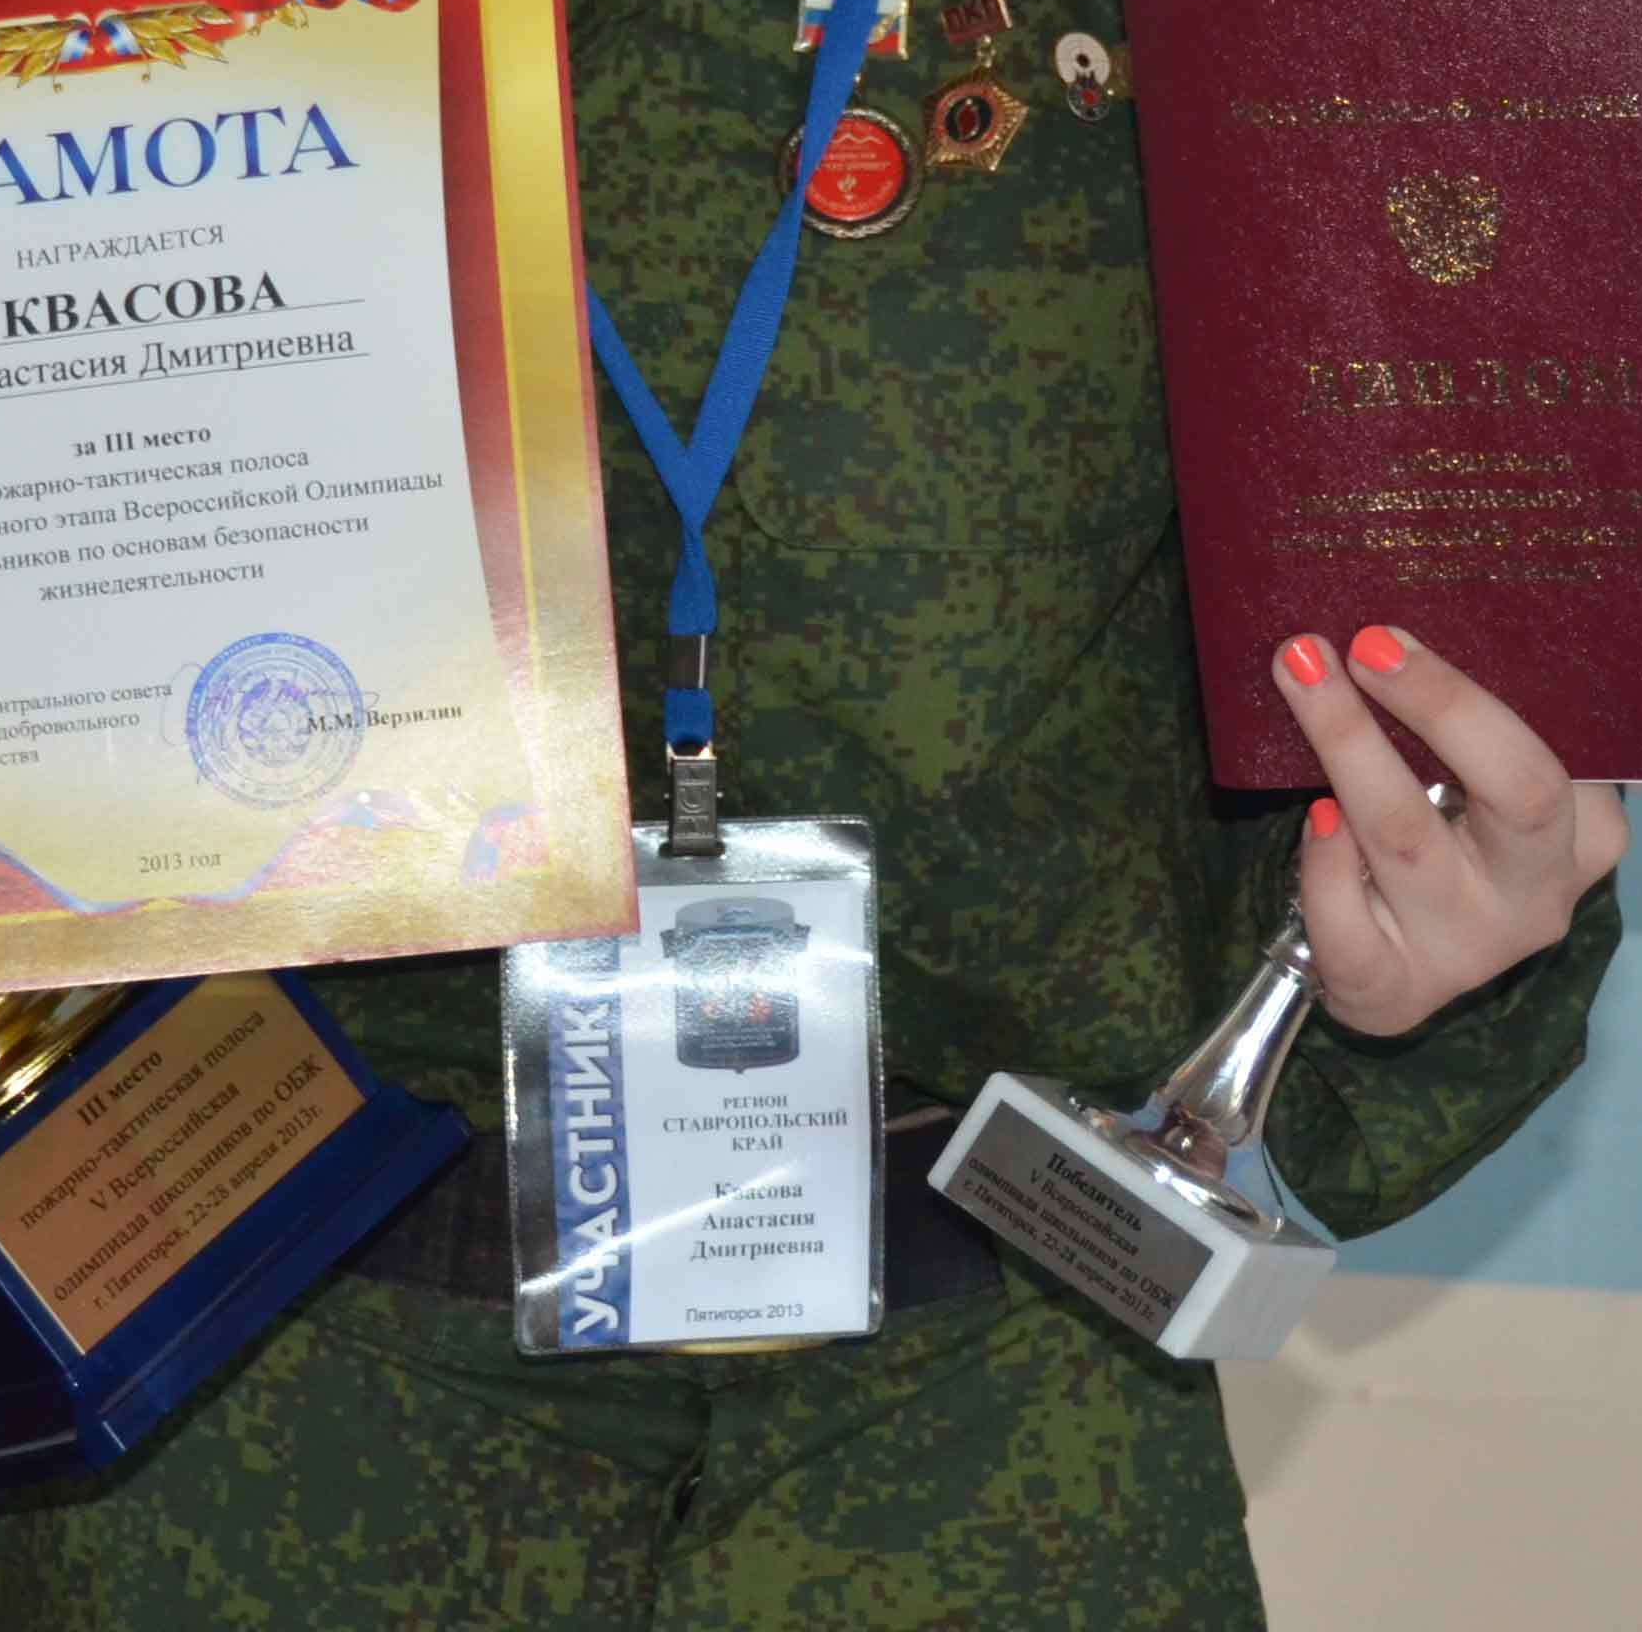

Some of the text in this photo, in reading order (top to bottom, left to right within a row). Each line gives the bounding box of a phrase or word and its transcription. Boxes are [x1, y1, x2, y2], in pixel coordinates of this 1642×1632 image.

[16, 224, 225, 269] НАГРАЖДАЕТСЯ
[1, 270, 286, 338] КВАСОВА
[139, 328, 355, 380] Дмитриевна
[72, 425, 213, 458] за III место
[229, 449, 310, 474] полоса
[55, 505, 119, 529] этапа
[123, 484, 299, 523] Всероссийской
[304, 471, 444, 503] Олимпиады
[77, 543, 107, 565] по
[110, 531, 208, 560] основам
[213, 513, 371, 548] безопасности
[38, 561, 265, 603] жизнедеятельности
[110, 680, 173, 703] совета
[307, 703, 463, 736] М.М. Верзилин
[139, 849, 223, 875] 2013 год
[76, 1052, 165, 1127] III место
[722, 1094, 789, 1111] РЕГИОН
[19, 1010, 267, 1232] пожарно-тактическая полоса
[663, 1110, 849, 1134] СТАВРОПОЛЬСКИЙ
[89, 1079, 241, 1213] V Всероссийская
[732, 1132, 784, 1153] КРАЙ
[53, 1055, 326, 1302] олимпиада школьников по ОБЖ
[186, 1182, 233, 1227] 22-28
[229, 1143, 281, 1195] апреля
[277, 1101, 325, 1151] 2013г.
[565, 999, 621, 1337] УЧАСТНИК
[701, 1207, 816, 1231] Анастасия
[689, 1237, 826, 1262] Дмитриевна
[685, 1302, 805, 1324] Пятигорск 2013
